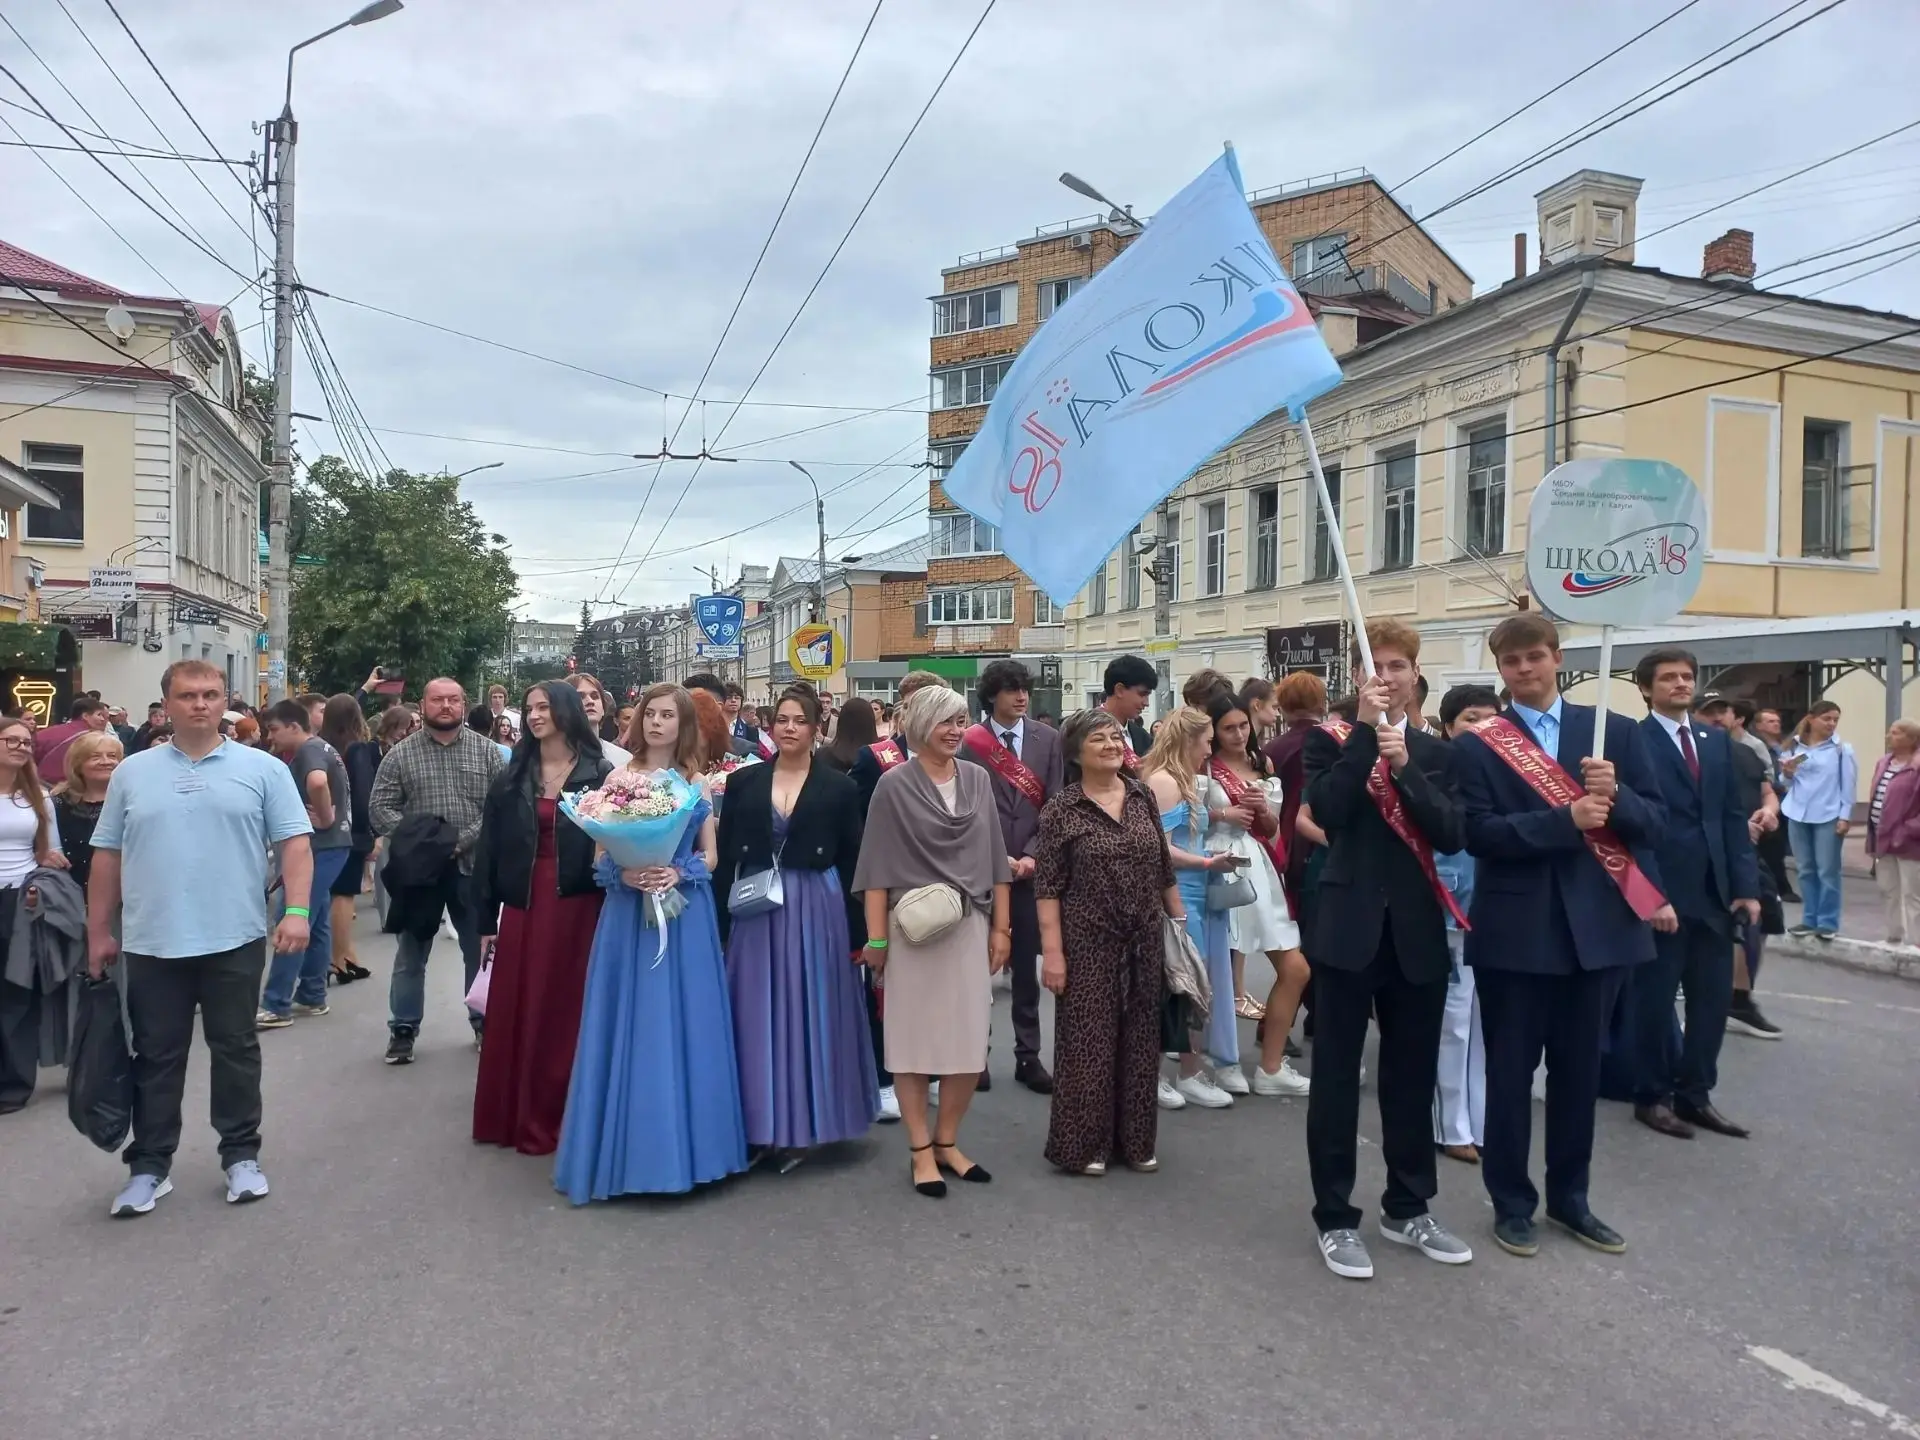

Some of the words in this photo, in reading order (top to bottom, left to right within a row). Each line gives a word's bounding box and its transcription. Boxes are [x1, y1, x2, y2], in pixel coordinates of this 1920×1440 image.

[1552, 479, 1575, 489] МБОУ
[1608, 502, 1634, 512] Калуги
[1545, 546, 1659, 575] ШКОЛА
[1658, 534, 1688, 575] 18
[92, 569, 132, 577] ТУРБЮРО
[91, 577, 133, 588] Визит
